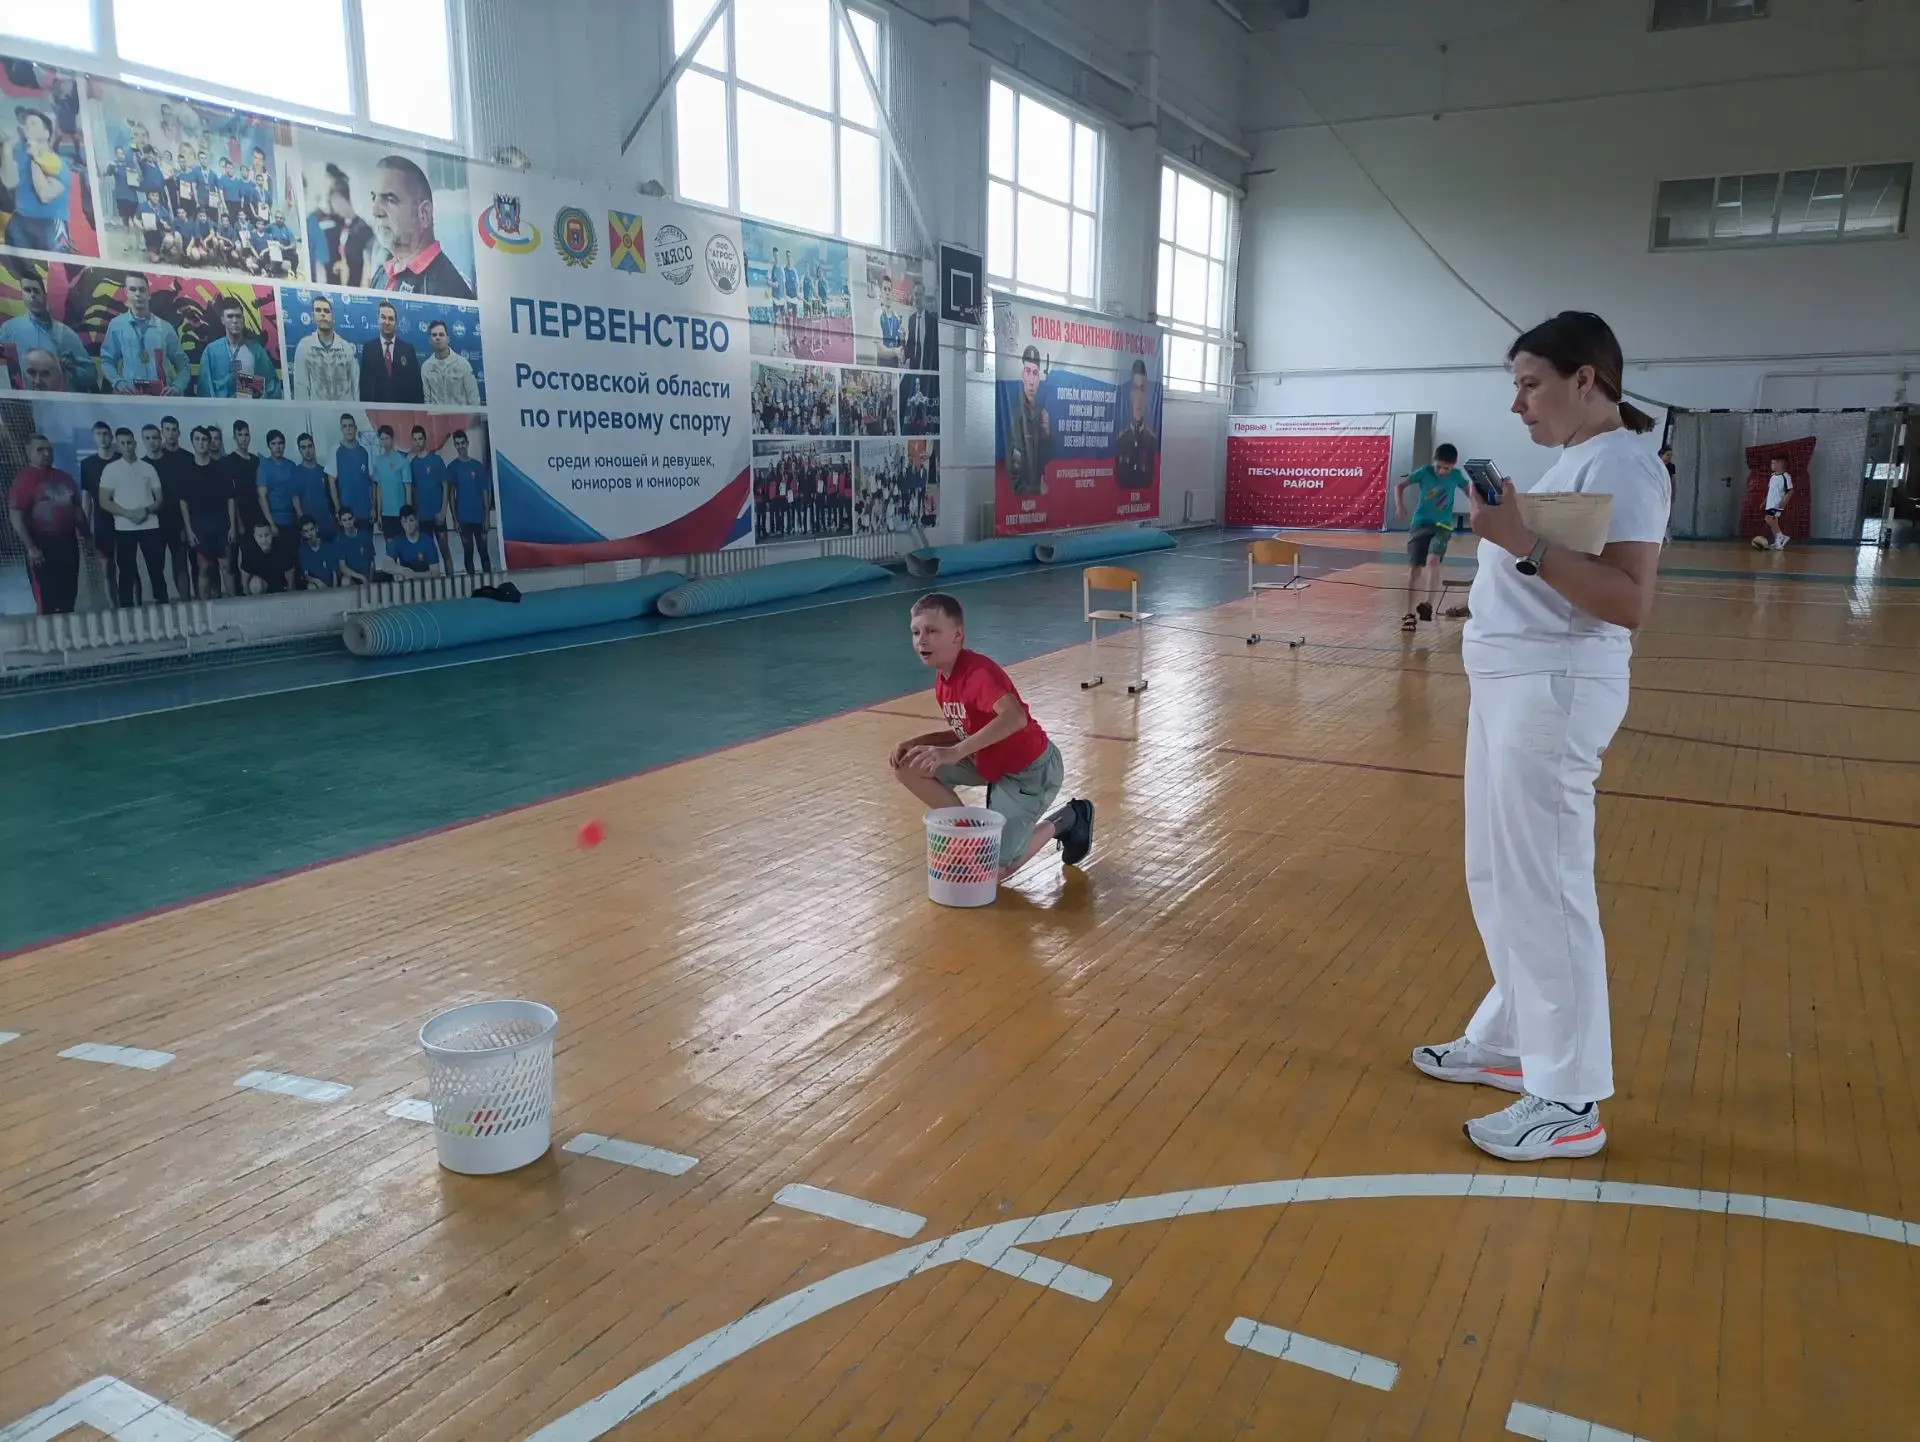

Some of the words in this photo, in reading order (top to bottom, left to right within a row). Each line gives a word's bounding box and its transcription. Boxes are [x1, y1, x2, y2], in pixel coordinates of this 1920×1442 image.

[716, 241, 728, 250] ООО
[660, 245, 693, 266] МЯСО
[510, 297, 729, 352] ПЕРВЕНСТВО
[1031, 316, 1061, 341] СЛАВА
[1064, 322, 1123, 350] ЗАЩИТНИКАМ
[515, 363, 650, 394] Ростовской
[656, 374, 730, 399] области
[520, 408, 550, 427] по
[557, 410, 664, 436] гиревому
[669, 413, 731, 436] спорту
[1234, 422, 1267, 432] Первые
[547, 455, 590, 471] среди
[594, 453, 648, 469] юношей
[652, 456, 659, 467] и
[662, 454, 715, 469] девушек,
[1247, 466, 1363, 478] ПЕСЧАНОКОПСКИЙ
[571, 476, 632, 491] юниоров
[636, 477, 643, 488] и
[647, 475, 700, 489] юниорок
[1283, 478, 1324, 489] РАЙОН
